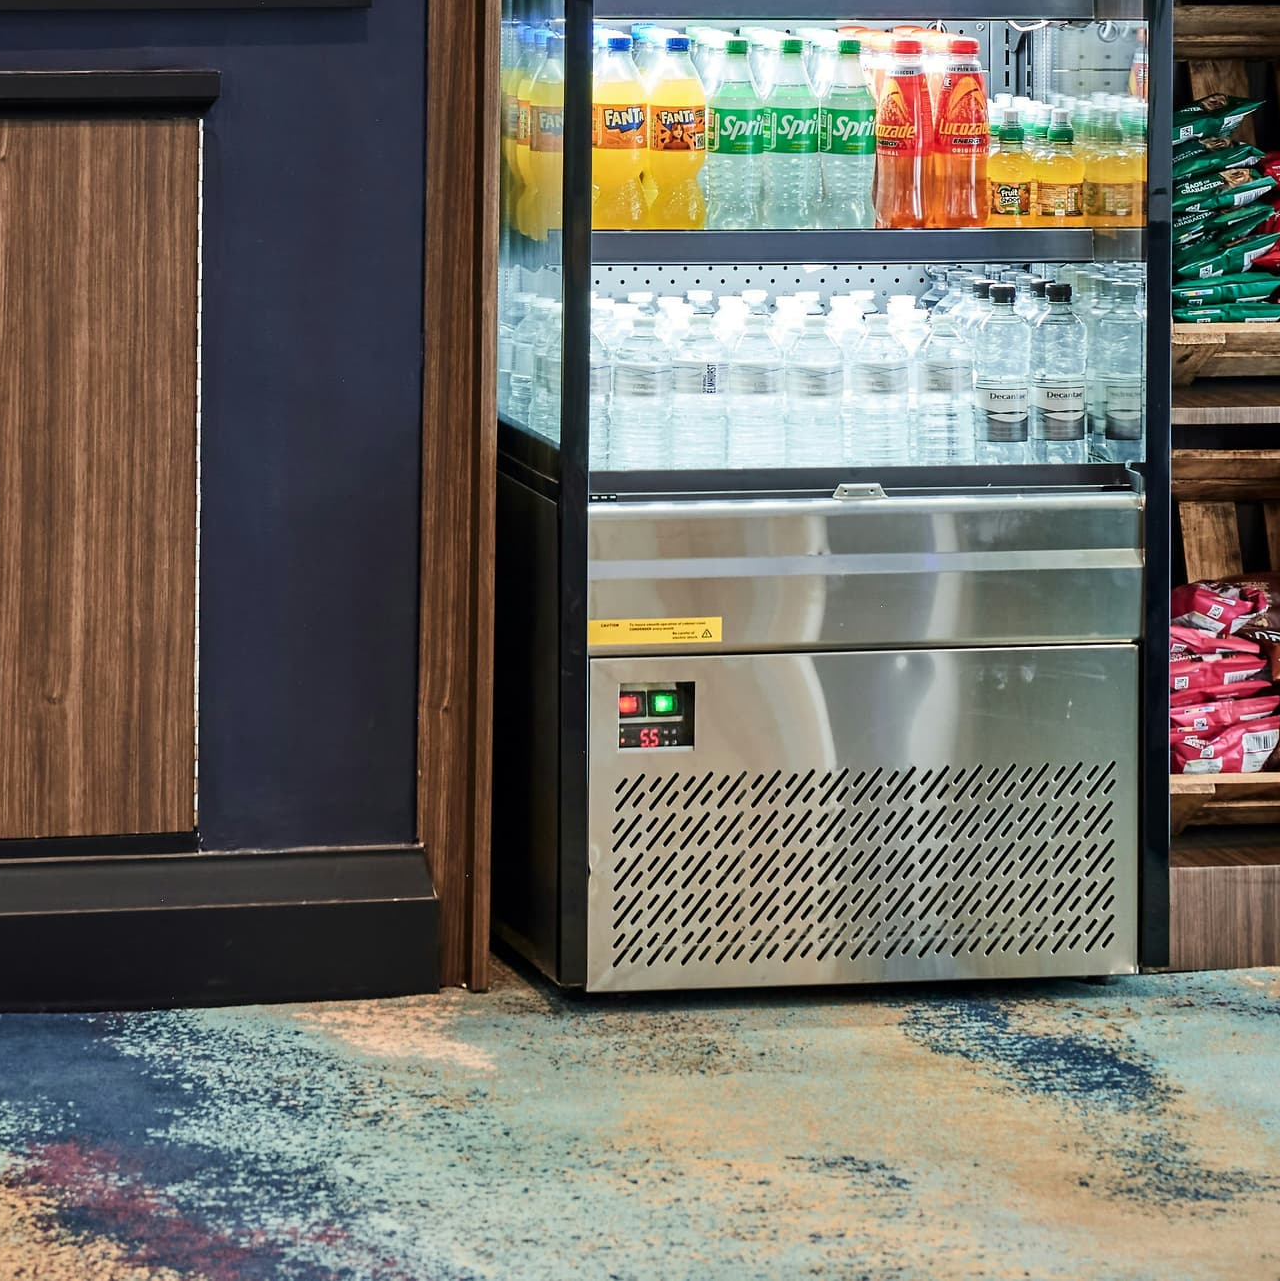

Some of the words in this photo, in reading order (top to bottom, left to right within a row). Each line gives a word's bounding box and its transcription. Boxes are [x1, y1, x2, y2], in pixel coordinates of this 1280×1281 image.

[539, 111, 563, 127] FAN
[604, 107, 644, 127] FANTA
[660, 109, 695, 125] FANTA
[952, 137, 982, 145] ENERGY
[1001, 188, 1018, 197] Fruit
